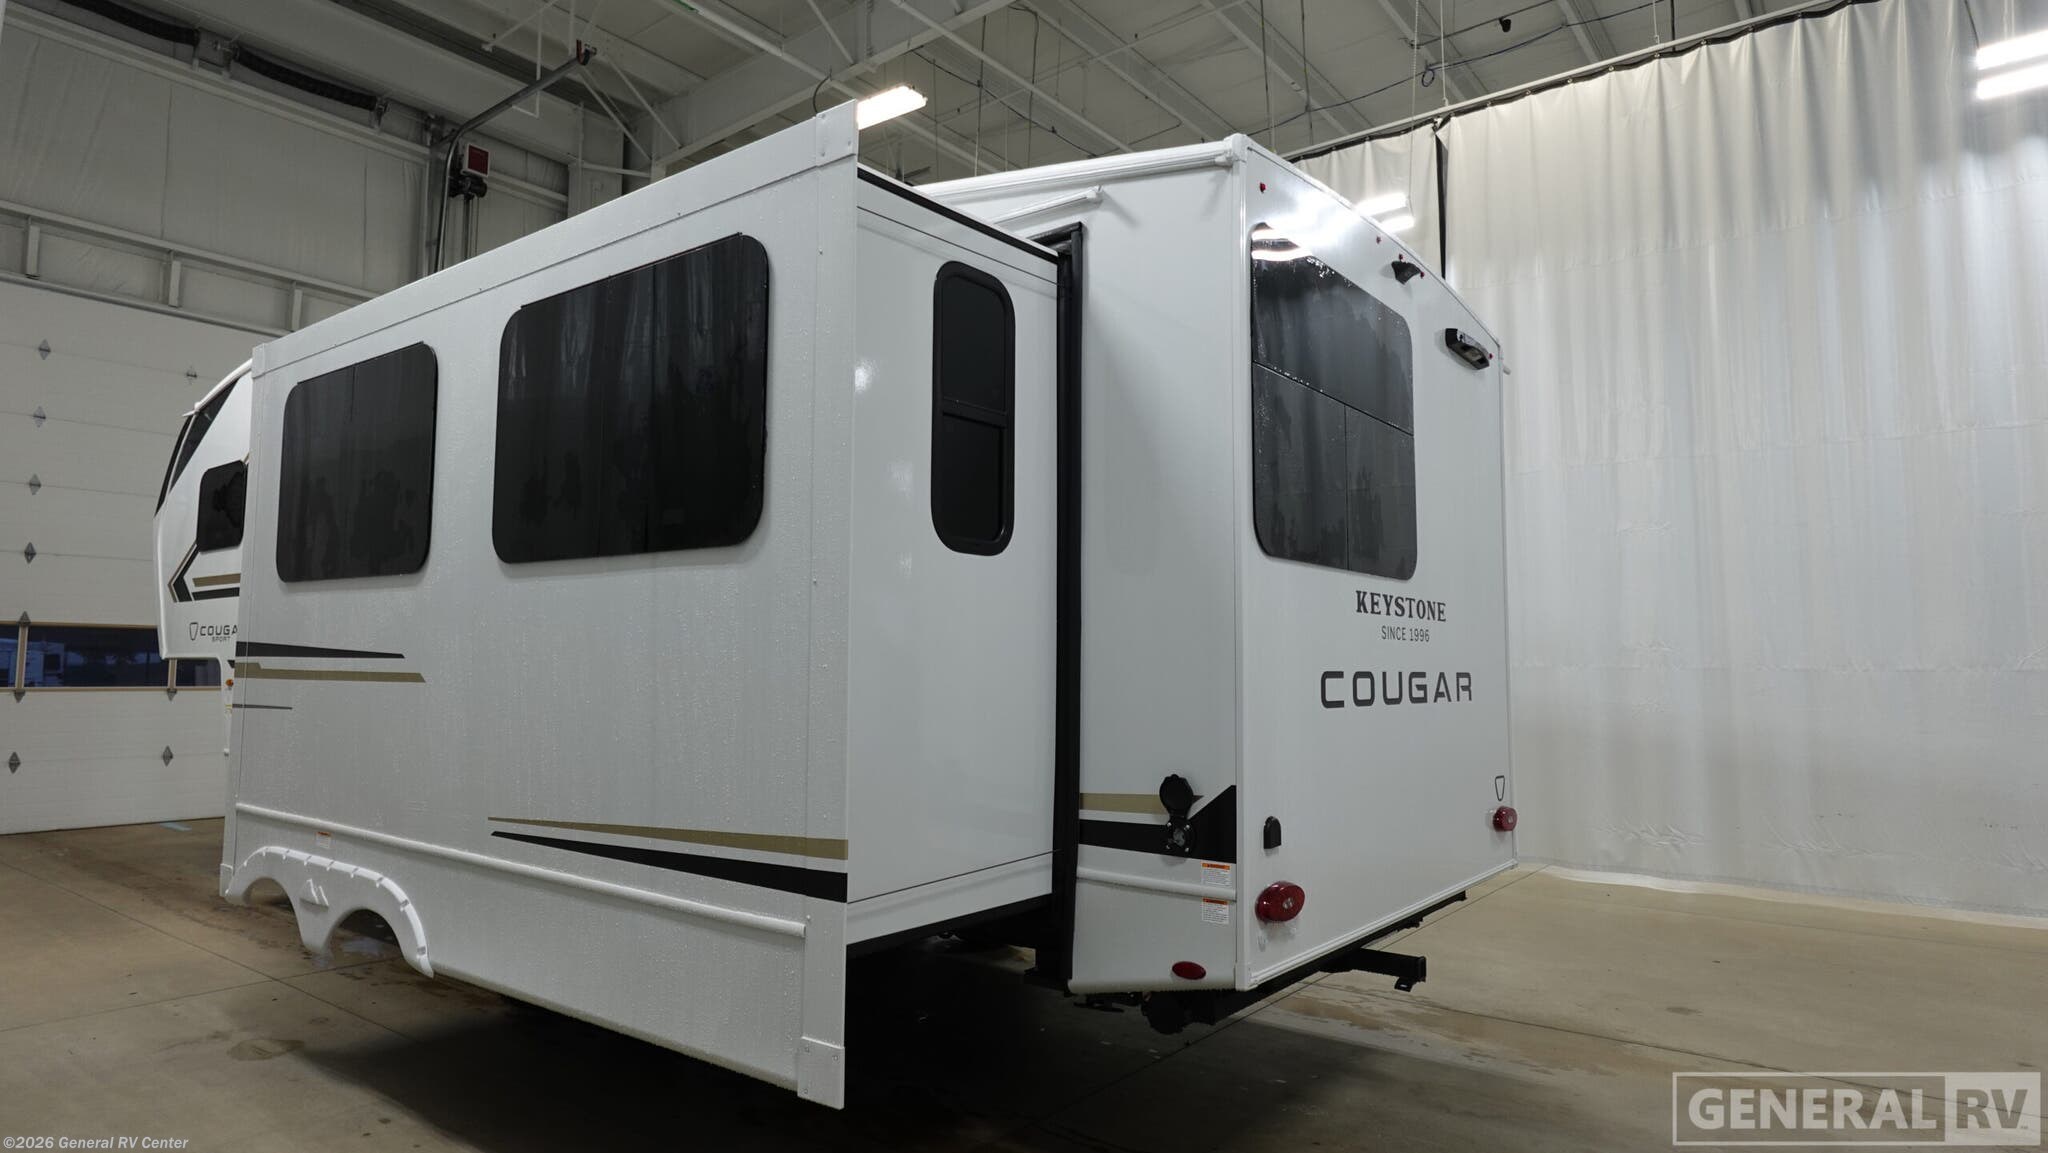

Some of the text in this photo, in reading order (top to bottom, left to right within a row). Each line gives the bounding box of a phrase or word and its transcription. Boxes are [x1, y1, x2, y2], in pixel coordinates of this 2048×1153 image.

[1355, 589, 1447, 622] KEYSTONE
[1381, 625, 1430, 643] SINCE 1996
[1320, 670, 1473, 709] COUGAR
